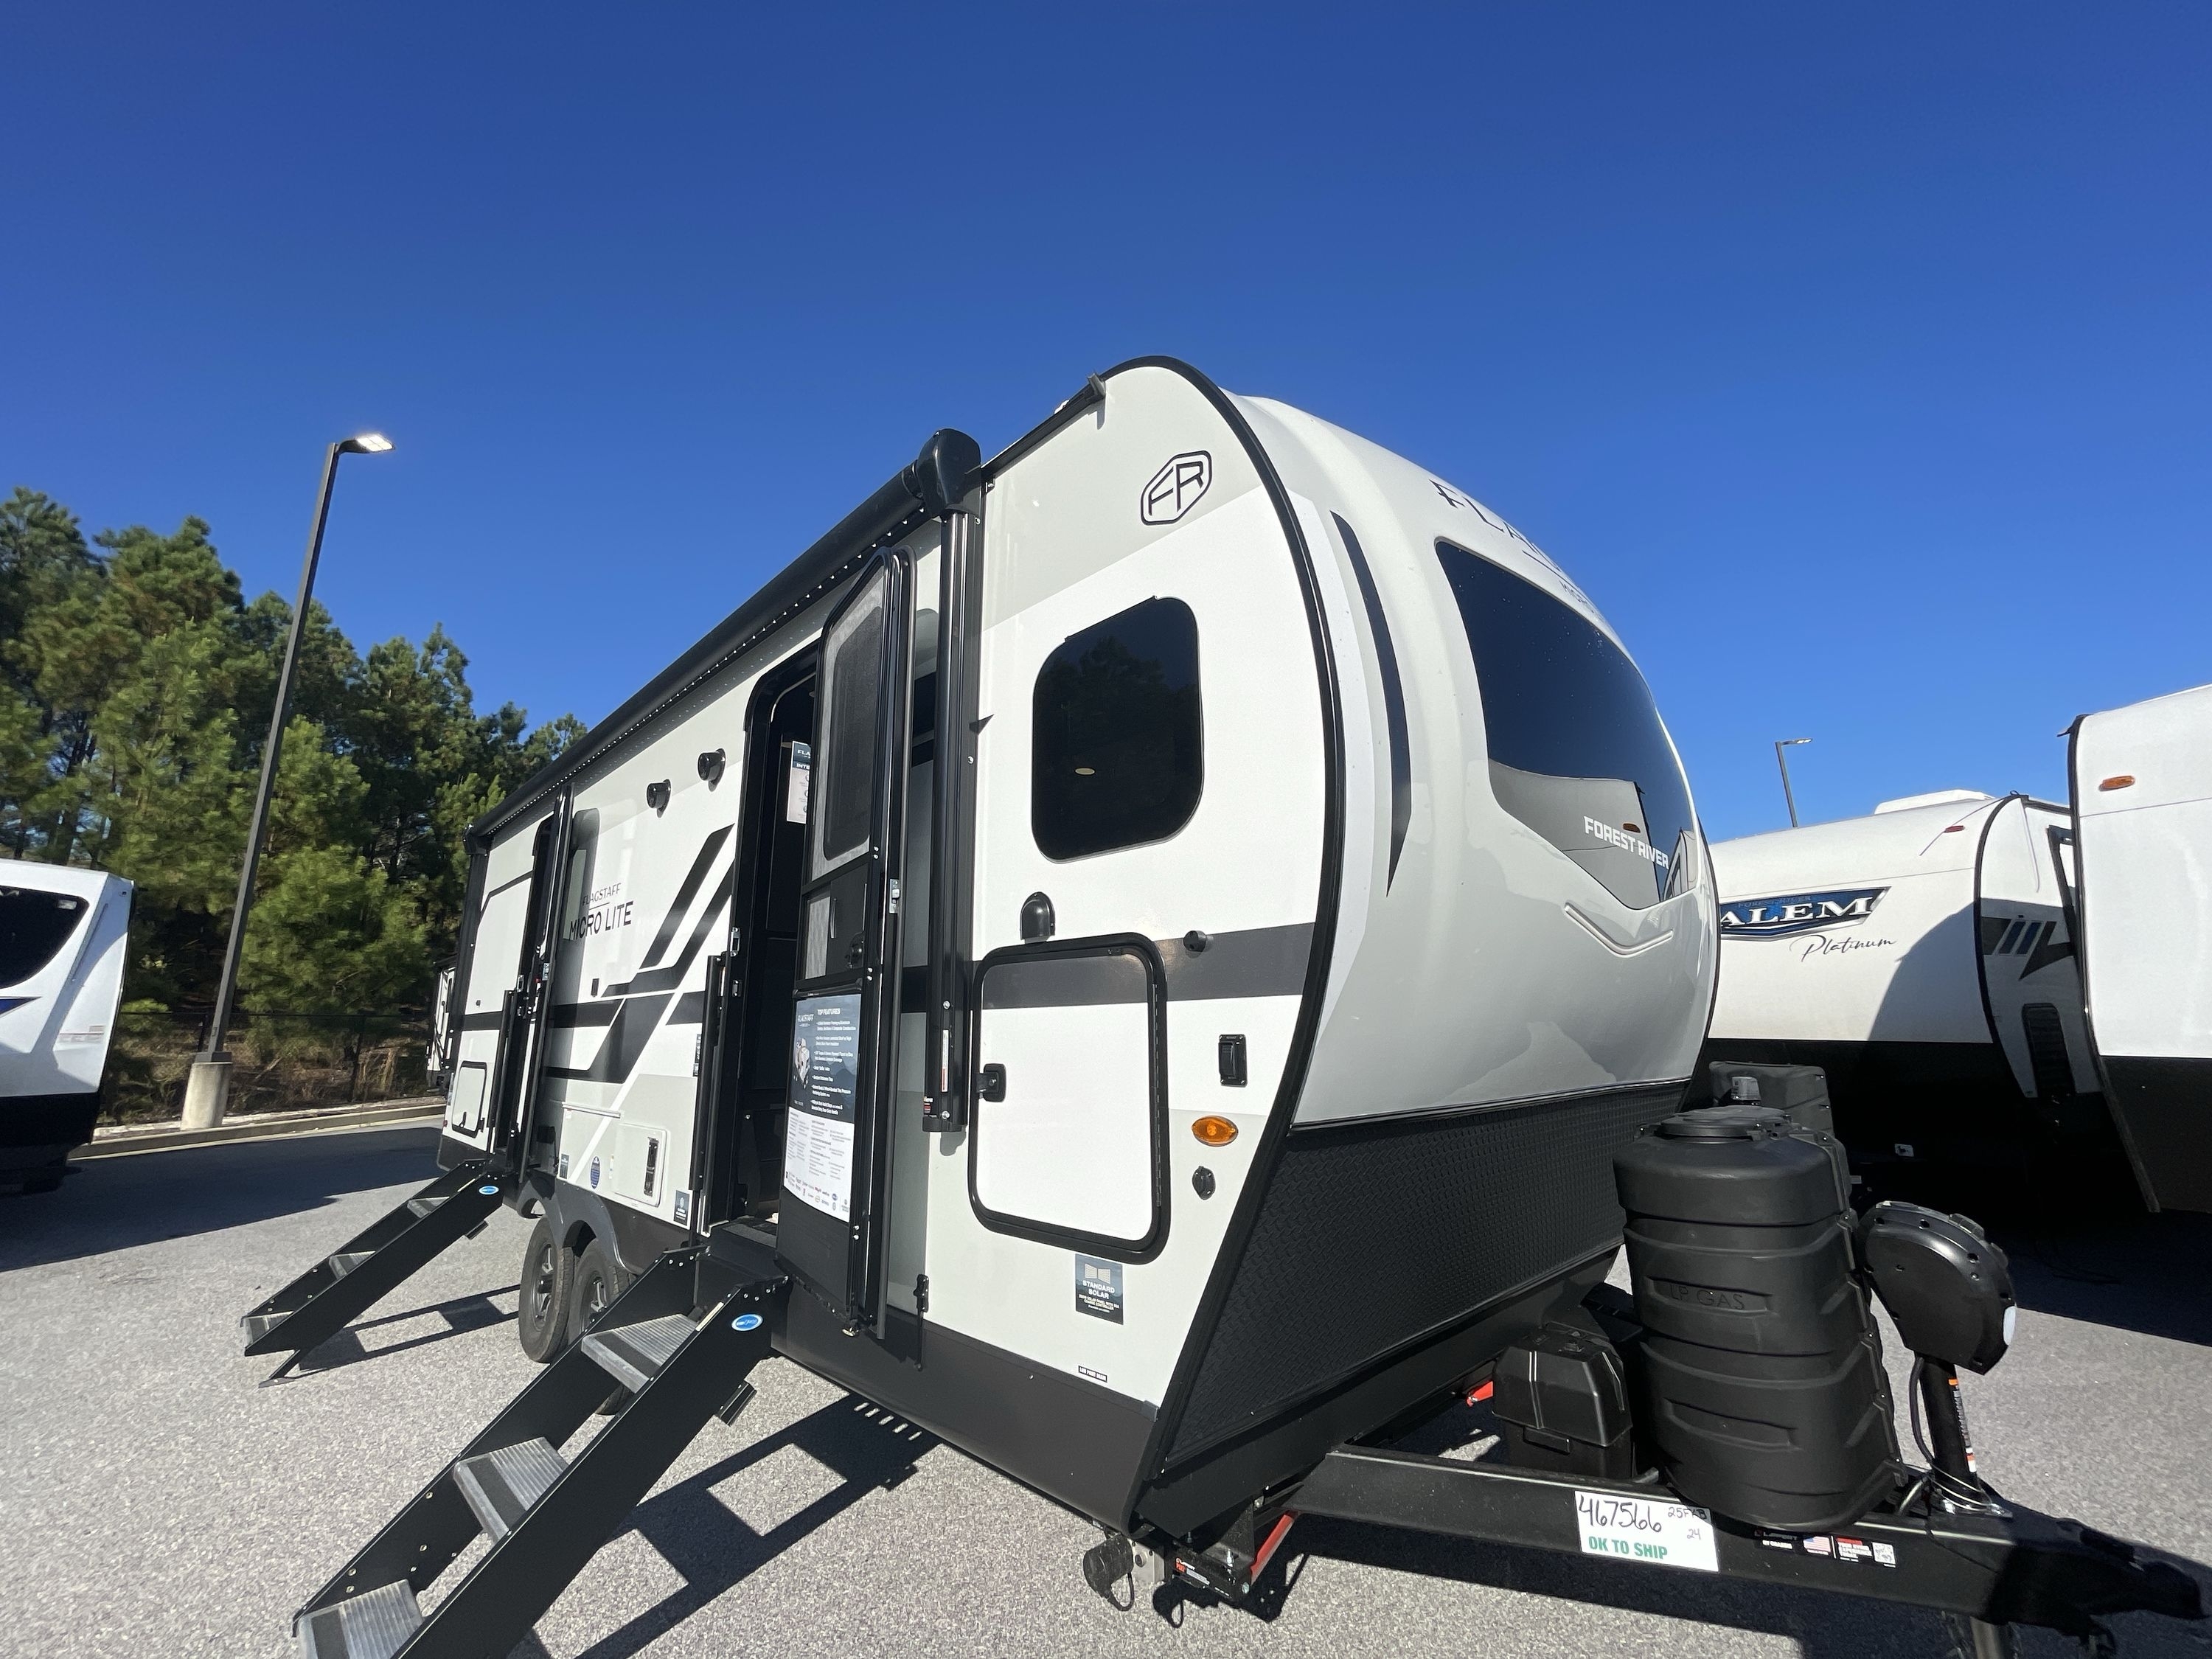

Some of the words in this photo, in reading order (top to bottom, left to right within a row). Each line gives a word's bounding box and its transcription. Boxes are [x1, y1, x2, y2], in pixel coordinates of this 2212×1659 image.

[1583, 815, 1636, 853] FOREST
[1636, 840, 1669, 870] RIVER
[582, 882, 622, 906] FLAGSTAFF
[568, 911, 602, 942] MICRO
[605, 900, 634, 931] LITE
[1789, 933, 1897, 962] Platinum
[1082, 1279, 1115, 1294] STANDARD
[1088, 1288, 1109, 1300] SOLAR
[1669, 1284, 1688, 1301] LP
[1697, 1289, 1745, 1310] GAS
[1578, 1494, 1662, 1533] 467566
[1686, 1528, 1702, 1540] 24
[1588, 1535, 1608, 1551] OK
[1610, 1538, 1630, 1555] TO
[1634, 1542, 1668, 1559] SHIP
